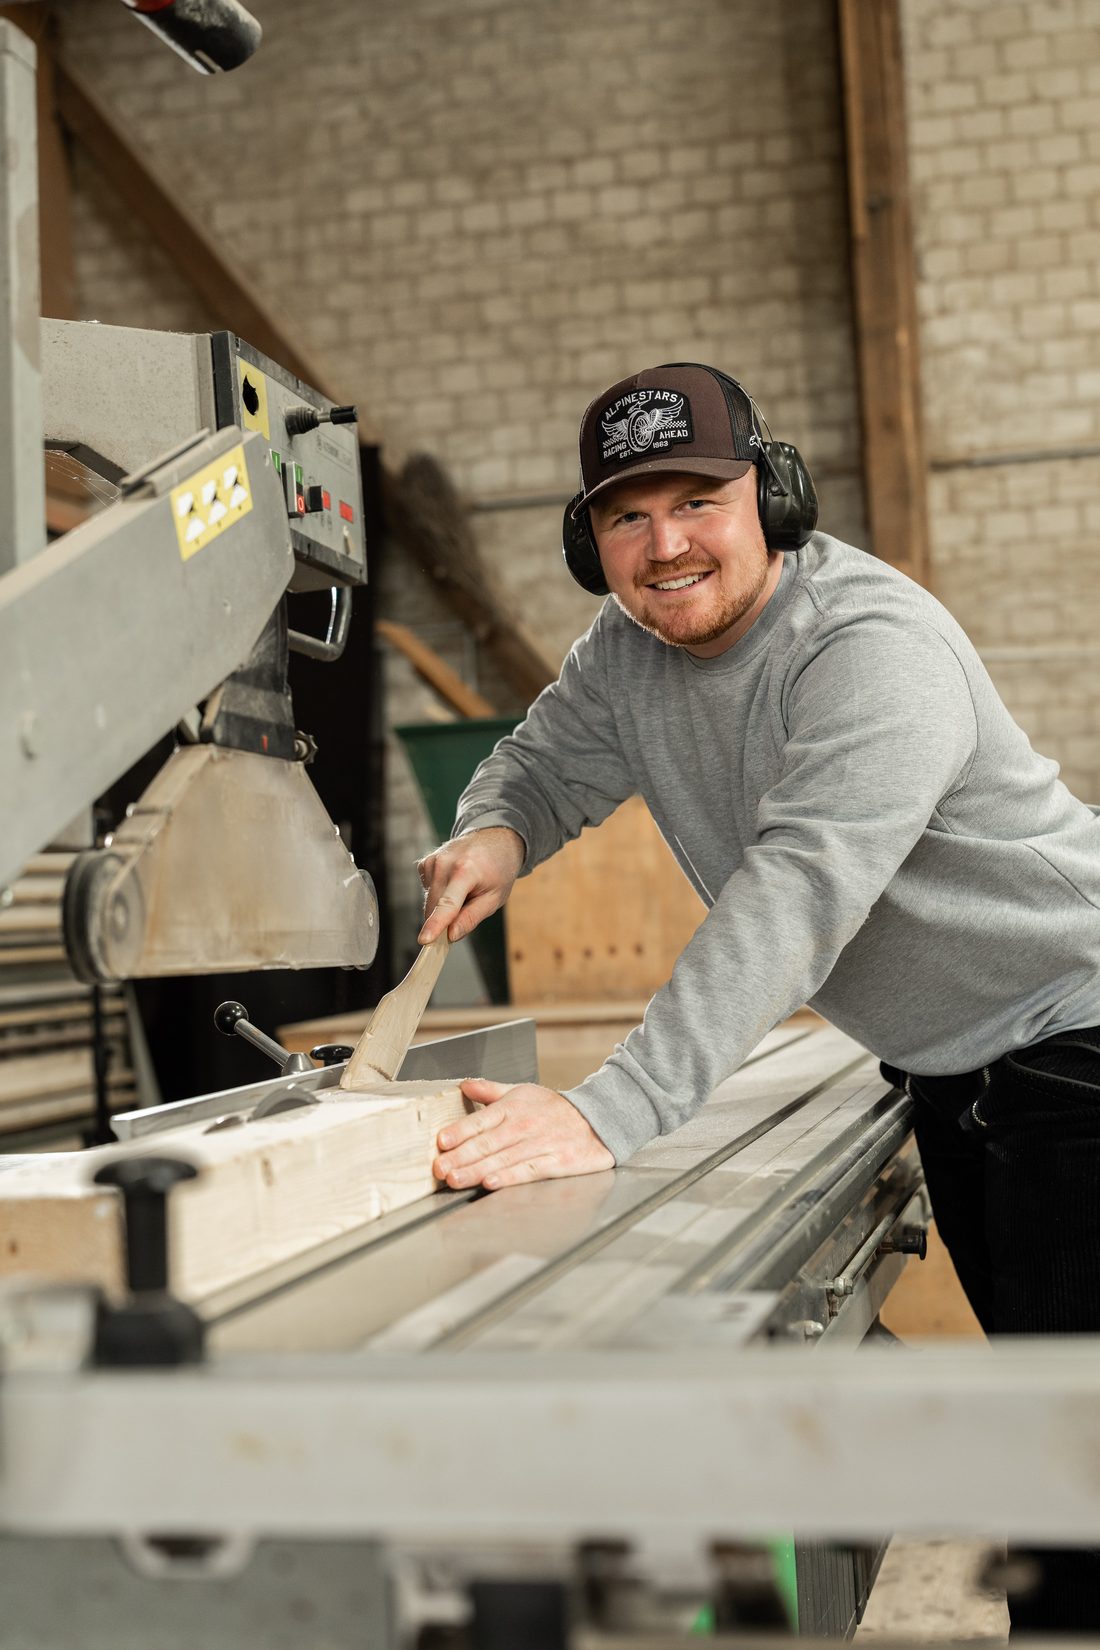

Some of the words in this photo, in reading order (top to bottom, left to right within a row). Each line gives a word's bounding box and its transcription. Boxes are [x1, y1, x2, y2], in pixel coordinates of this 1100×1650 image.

[605, 390, 678, 421] ALPINESTARS
[659, 429, 689, 440] AHEAD
[603, 442, 627, 459] RACING
[619, 449, 633, 459] EST.
